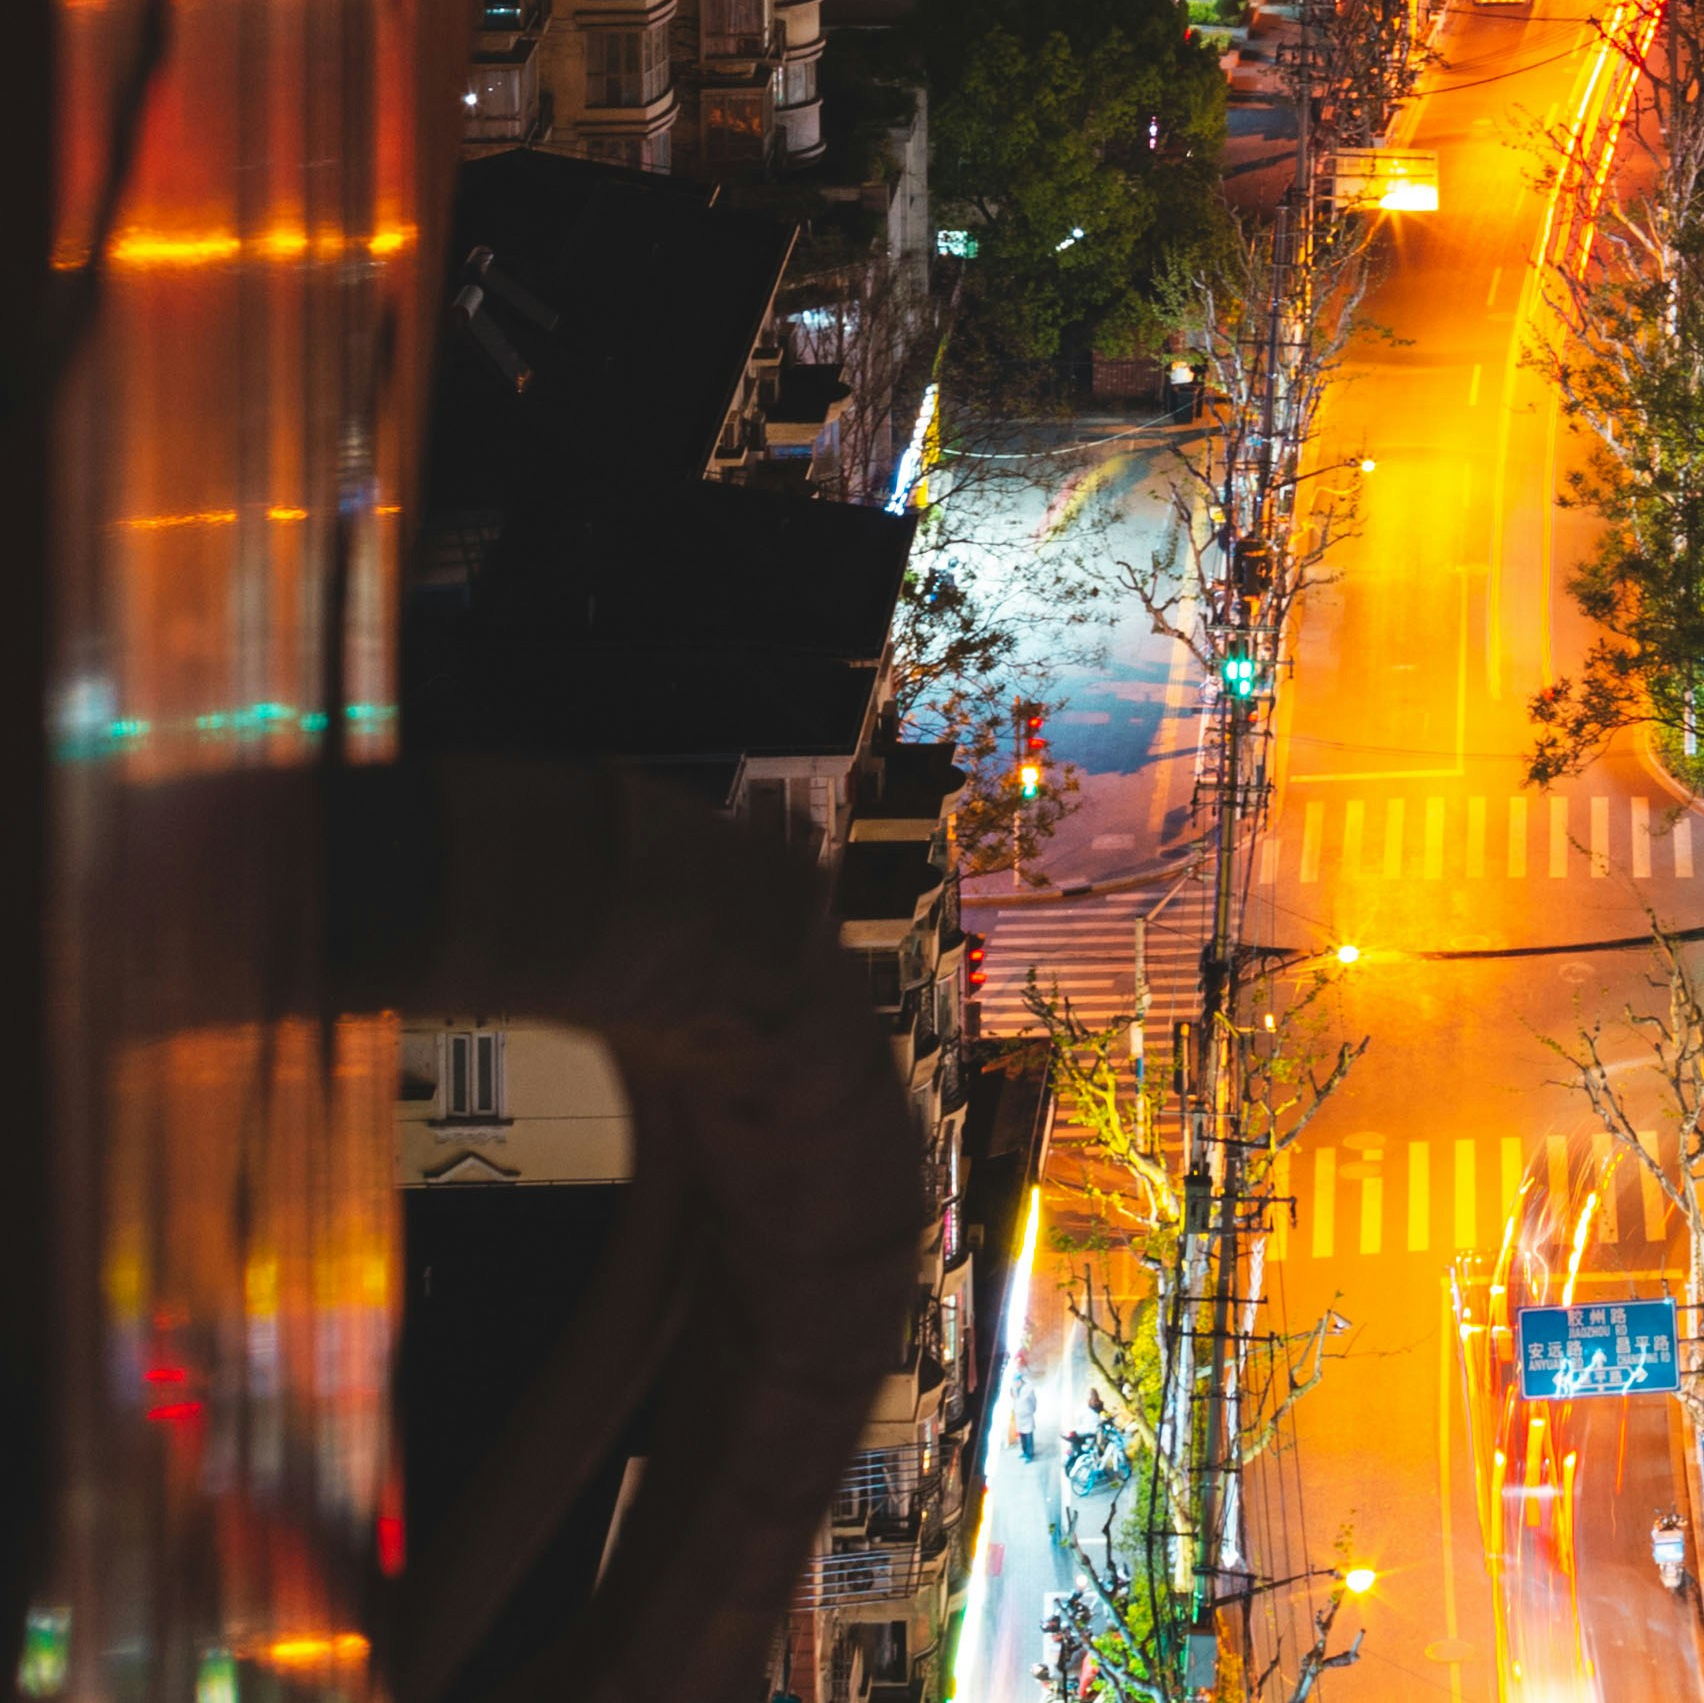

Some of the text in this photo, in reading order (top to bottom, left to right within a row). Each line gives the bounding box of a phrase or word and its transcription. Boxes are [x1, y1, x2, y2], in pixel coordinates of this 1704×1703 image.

[1568, 1307, 1626, 1326] 胶州路
[1528, 1341, 1582, 1359] 安远路
[1616, 1335, 1669, 1353] 昌平路
